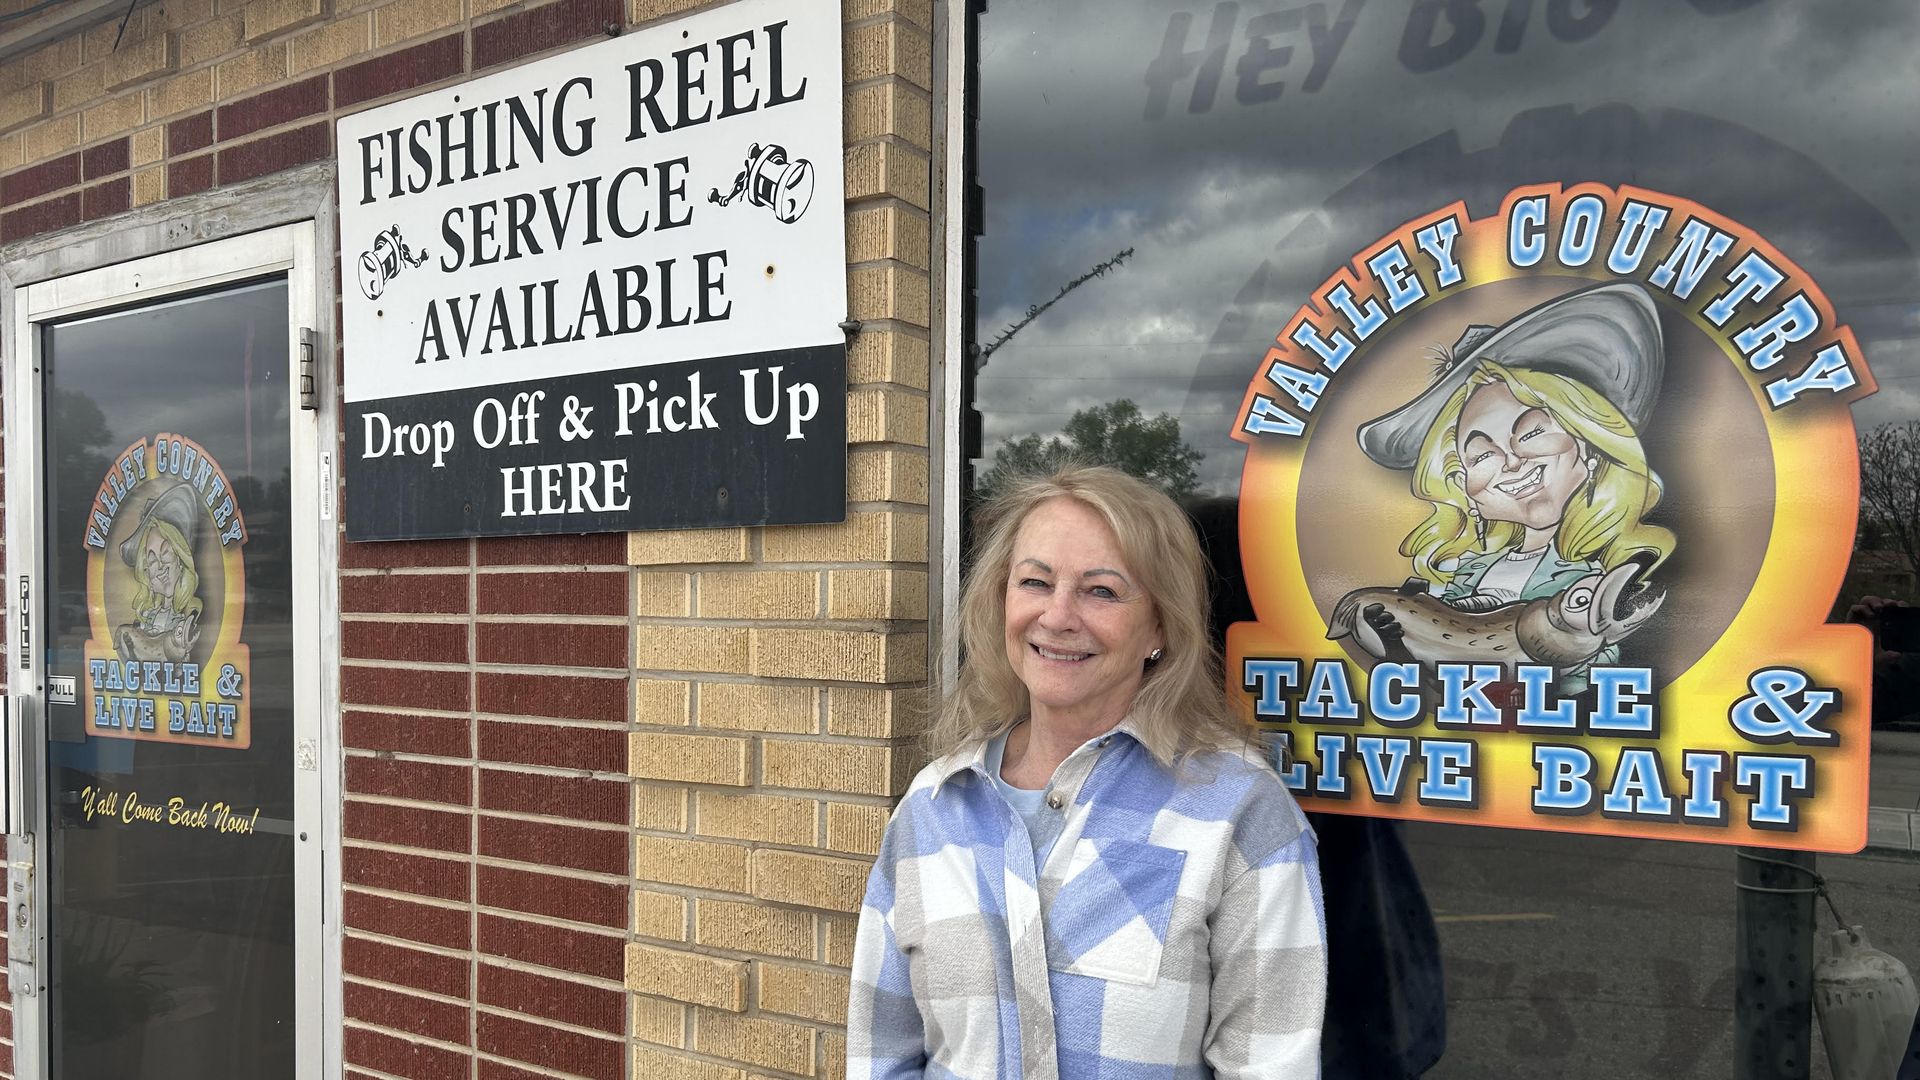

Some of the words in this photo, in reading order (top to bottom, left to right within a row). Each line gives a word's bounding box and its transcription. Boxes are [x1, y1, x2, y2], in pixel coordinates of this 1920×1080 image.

[358, 77, 597, 206] FISHING
[625, 20, 808, 142] REEL
[440, 156, 694, 273] SERVICE
[415, 249, 732, 365] AVAILABLE
[1242, 213, 1465, 439] VALLEY
[1506, 192, 1861, 411] COUNTRY
[362, 411, 455, 469] Drop
[473, 390, 545, 450] Off
[558, 394, 594, 442] &
[614, 370, 719, 437] Pick
[740, 364, 820, 442] Up
[87, 444, 148, 549] VALLEY
[156, 439, 244, 547] COUNTRY
[500, 458, 631, 519] HERE
[20, 581, 29, 648] PULL
[49, 683, 74, 696] PULL
[90, 659, 201, 695] TACKLE
[216, 663, 242, 698] &
[95, 695, 155, 731] LIVE
[169, 700, 237, 737] BAIT
[1243, 658, 1656, 735] TACKLE
[1730, 666, 1837, 743] &
[81, 785, 118, 822] Y'all
[121, 791, 163, 824] Come
[168, 796, 208, 829] Back
[211, 801, 260, 835] Now!
[1262, 731, 1476, 804] LIVE
[1532, 745, 1810, 826] BAIT
